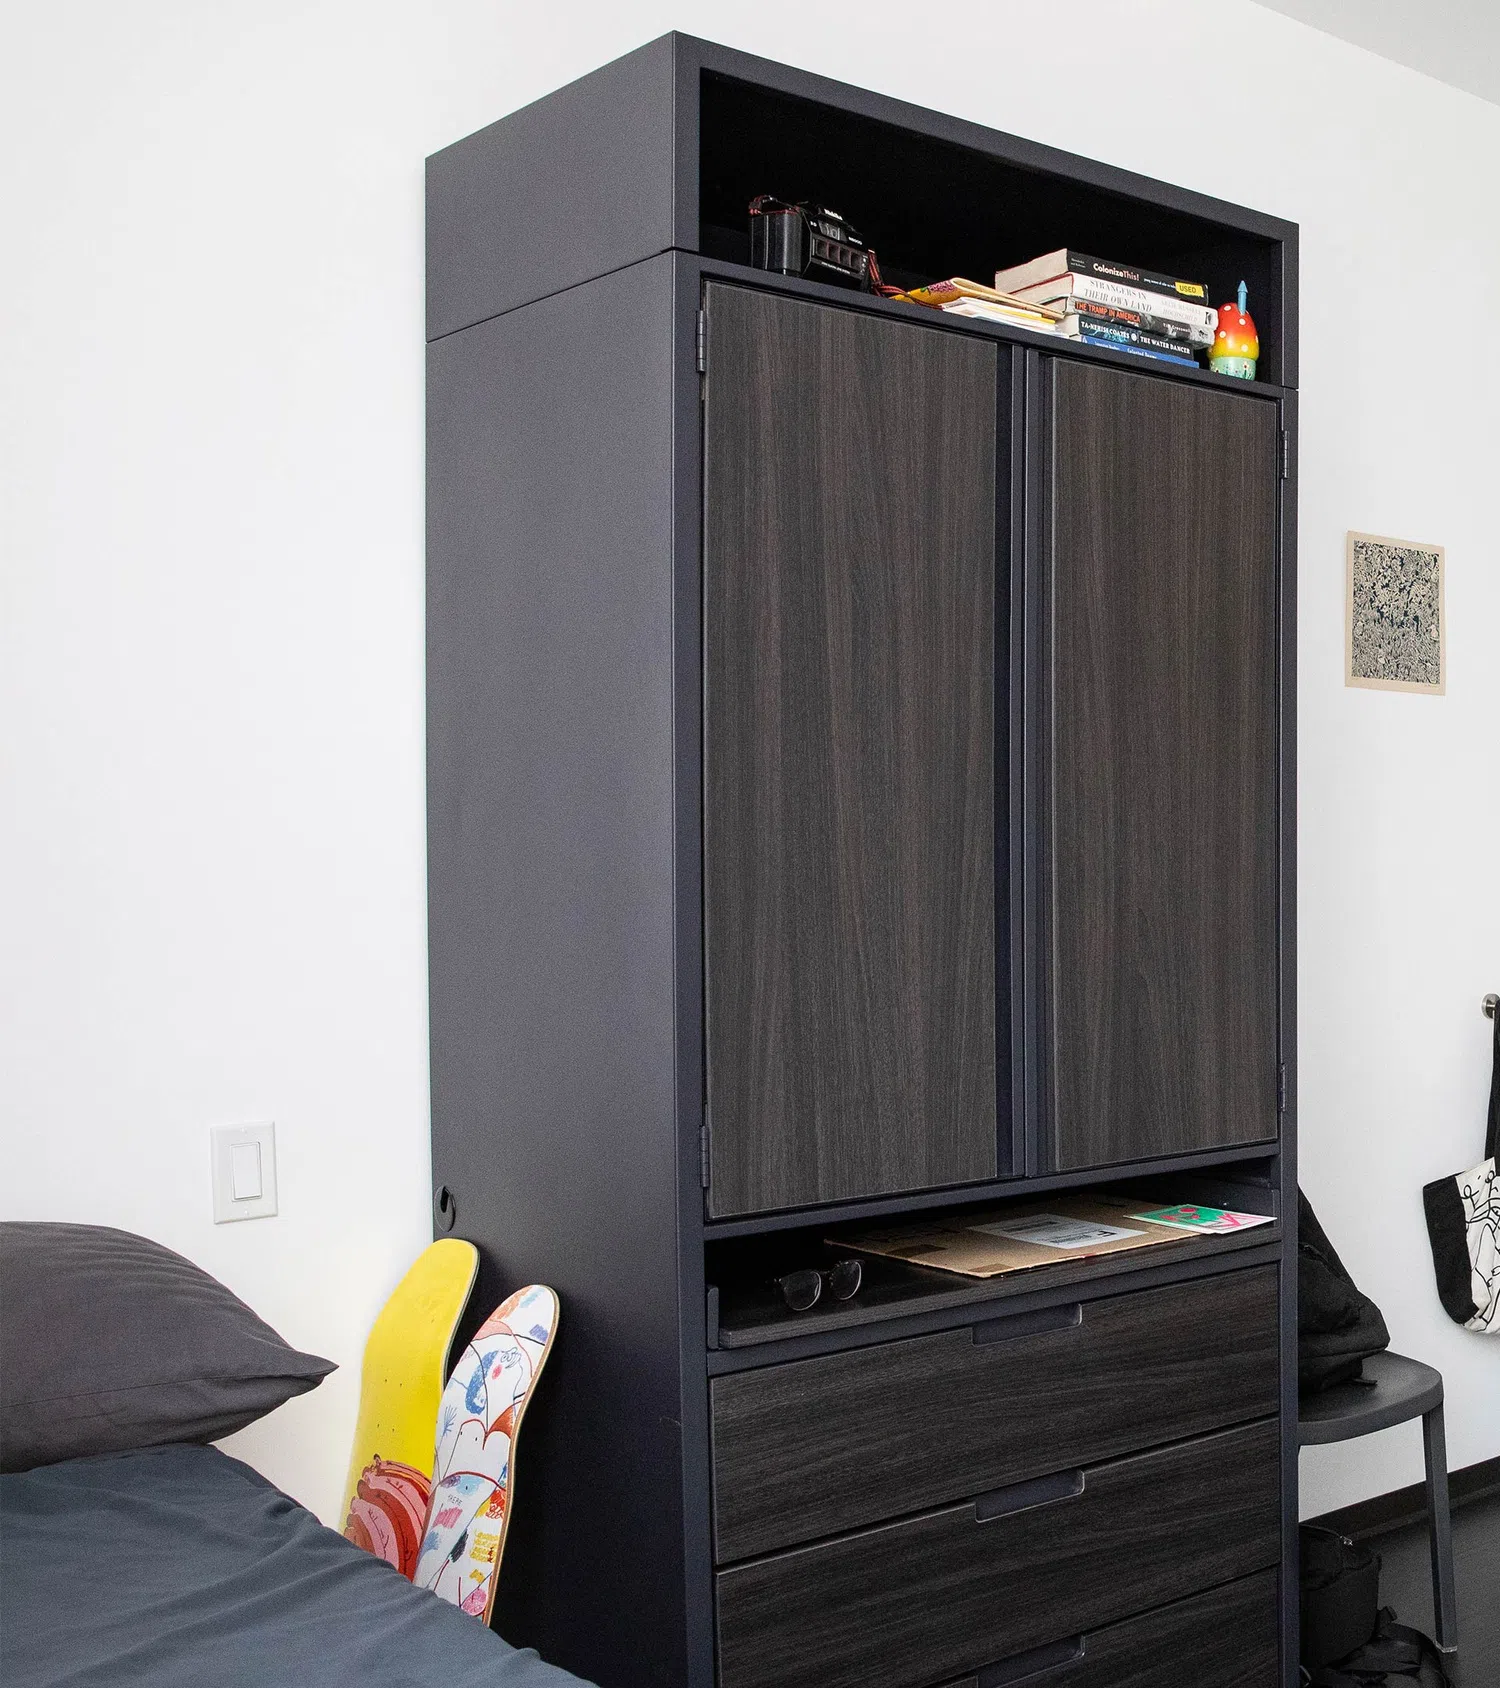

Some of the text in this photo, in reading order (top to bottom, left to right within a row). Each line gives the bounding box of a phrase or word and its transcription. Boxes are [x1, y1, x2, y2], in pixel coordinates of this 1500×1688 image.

[1090, 279, 1136, 297] STRANGERS
[1137, 291, 1147, 300] IN
[1179, 285, 1197, 293] USED
[1084, 288, 1152, 312] THEIR OWN LAND
[1075, 301, 1141, 322] THE TRAMP IN AMERICA
[1109, 328, 1130, 339] COATES
[1140, 335, 1191, 355] THE WATER DANCER
